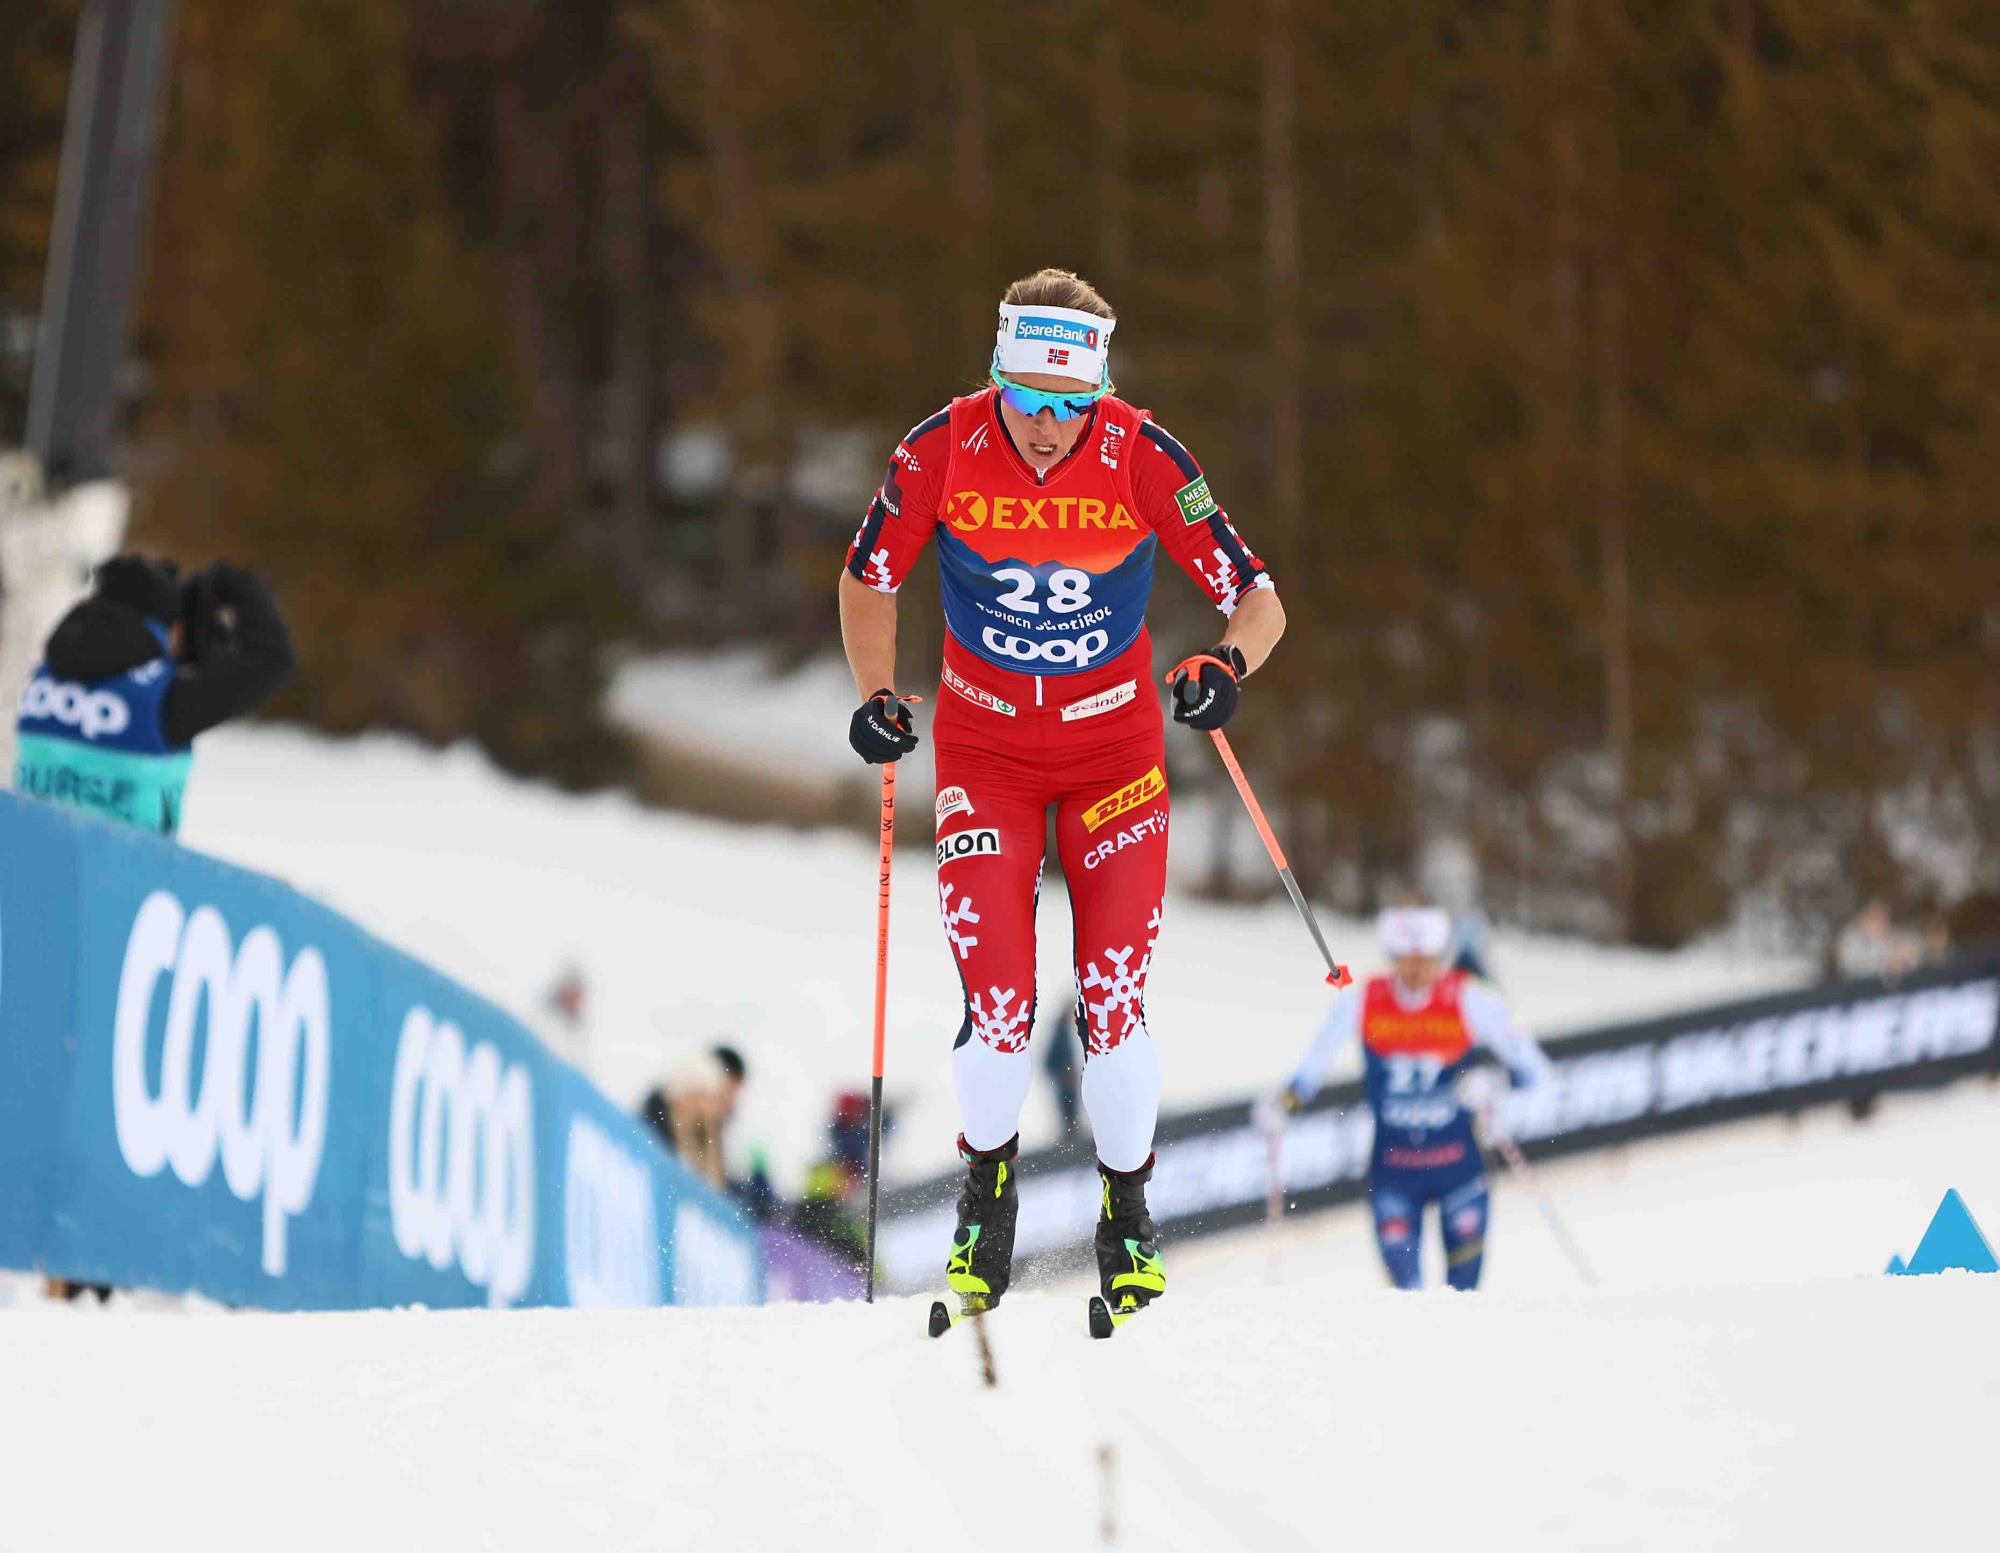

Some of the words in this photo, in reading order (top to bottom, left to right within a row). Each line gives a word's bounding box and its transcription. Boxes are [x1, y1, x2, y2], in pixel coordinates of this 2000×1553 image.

[1017, 321, 1085, 343] SpareBank
[992, 497, 1138, 530] EXTRA
[991, 568, 1092, 614] 28
[982, 627, 1109, 668] coop
[943, 667, 994, 708] SPAR
[1095, 778, 1160, 822] DHL
[1084, 816, 1157, 870] CRAFT
[112, 889, 330, 1277] coop
